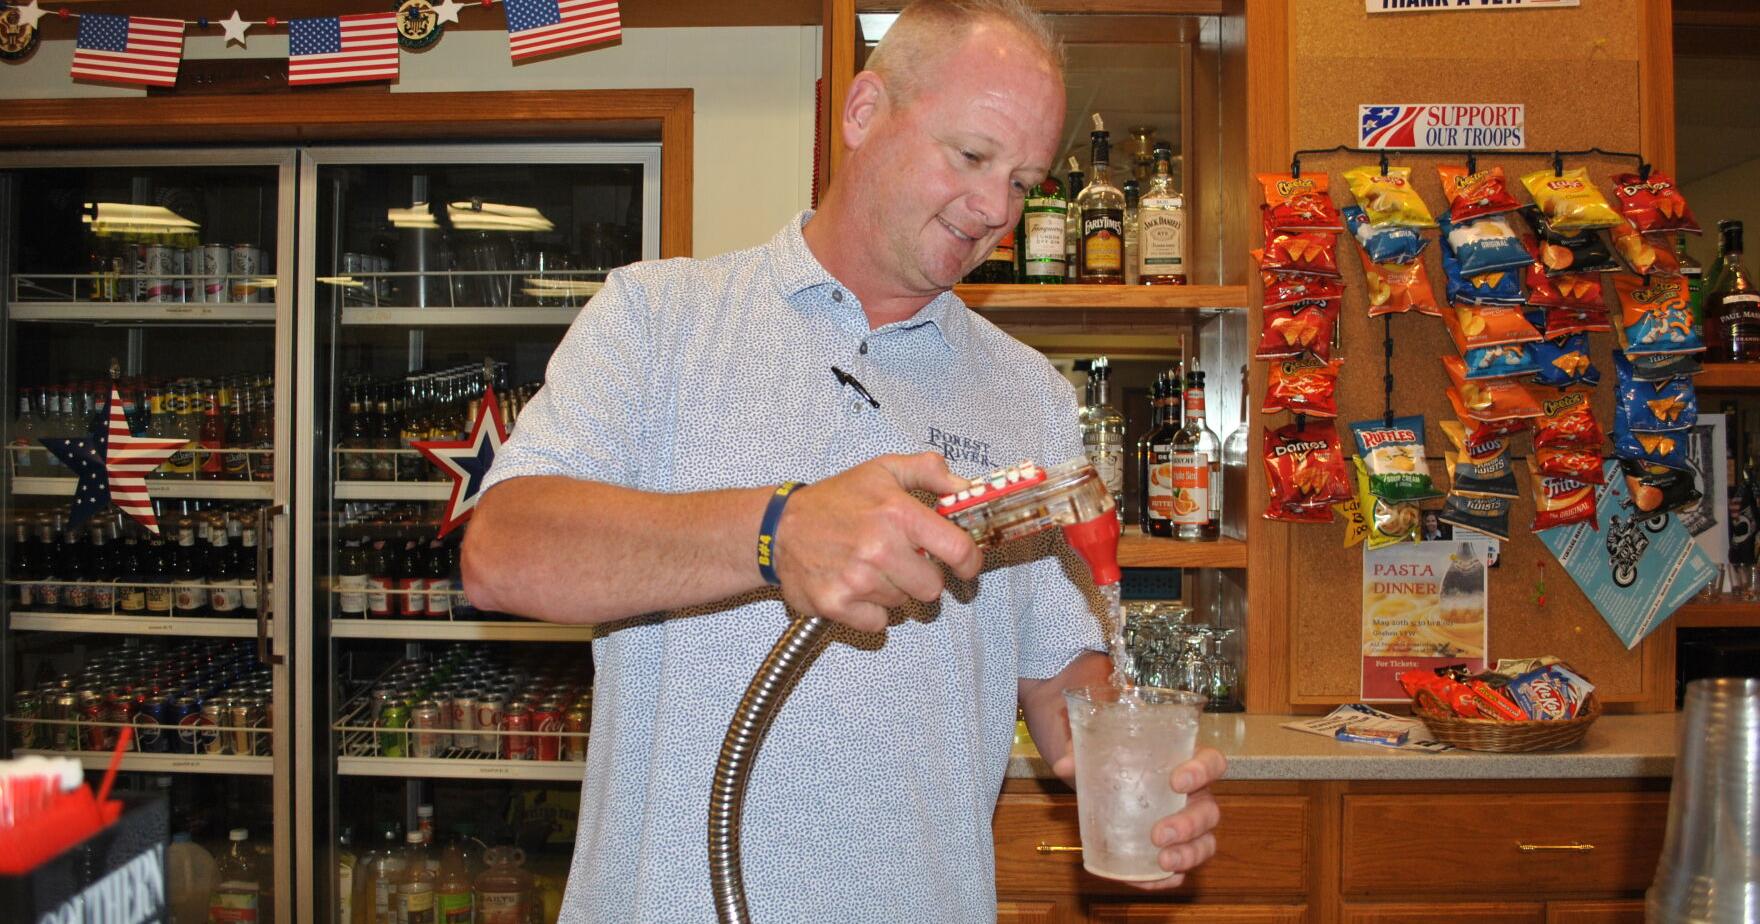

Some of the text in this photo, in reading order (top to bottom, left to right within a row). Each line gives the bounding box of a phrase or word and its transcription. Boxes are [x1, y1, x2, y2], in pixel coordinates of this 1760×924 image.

[1426, 106, 1521, 127] SUPPORT
[1426, 127, 1521, 147] OUR TROOPS
[1084, 216, 1122, 236] EARLY TIMES
[1143, 219, 1158, 231] JACK
[1719, 311, 1742, 324] PAUL
[1543, 392, 1584, 417] Cheetos
[928, 426, 991, 454] FOREST
[1275, 439, 1329, 457] Doritos
[1360, 430, 1416, 449] RUFFLES
[943, 442, 992, 468] RIVER
[1542, 475, 1589, 498] Frito
[1559, 502, 1590, 519] ORIGINAL
[758, 534, 772, 566] B#4
[1373, 563, 1435, 577] PASTA
[1373, 582, 1438, 595] DINNER
[1375, 660, 1420, 668] For Tickets:
